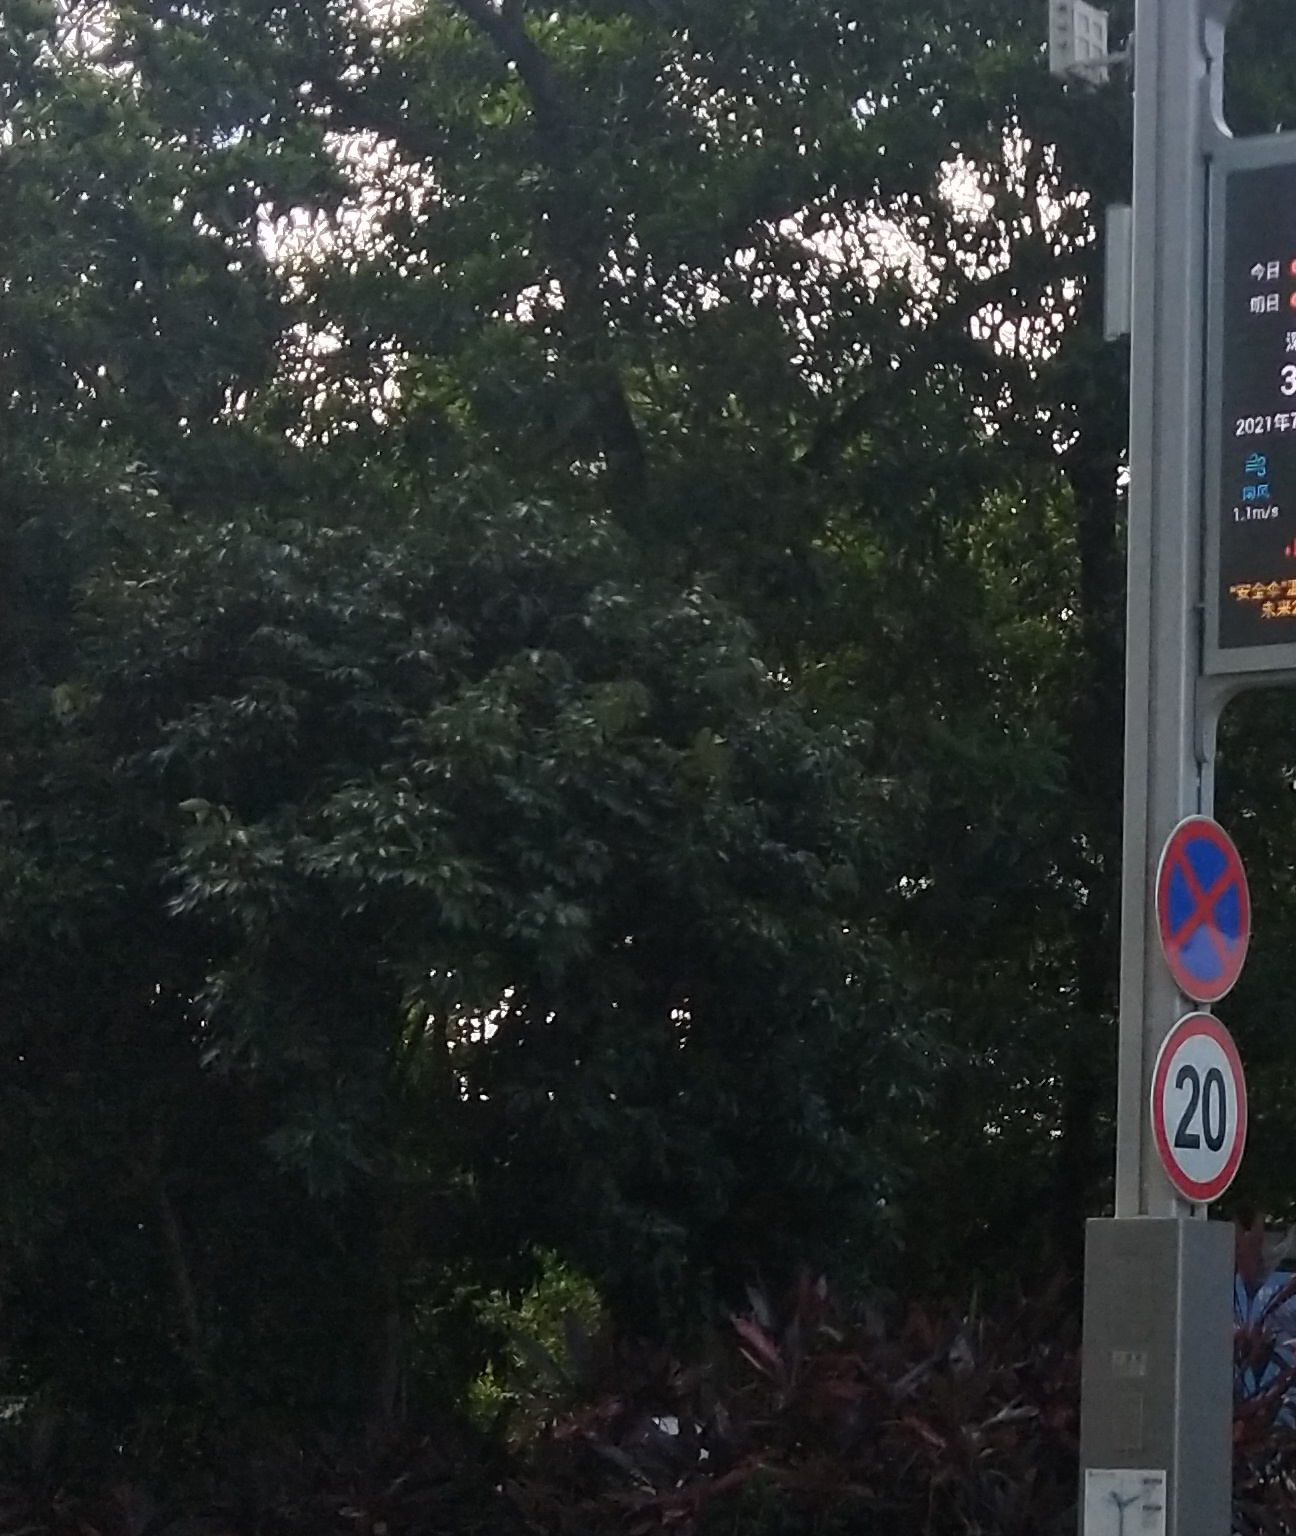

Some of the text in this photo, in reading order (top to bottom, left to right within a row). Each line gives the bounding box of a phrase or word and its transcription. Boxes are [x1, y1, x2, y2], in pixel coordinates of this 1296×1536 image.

[1250, 261, 1280, 281] 今日
[1250, 293, 1280, 313] 明日
[1233, 505, 1279, 522] 1.1m/s
[1174, 1064, 1227, 1152] 20
